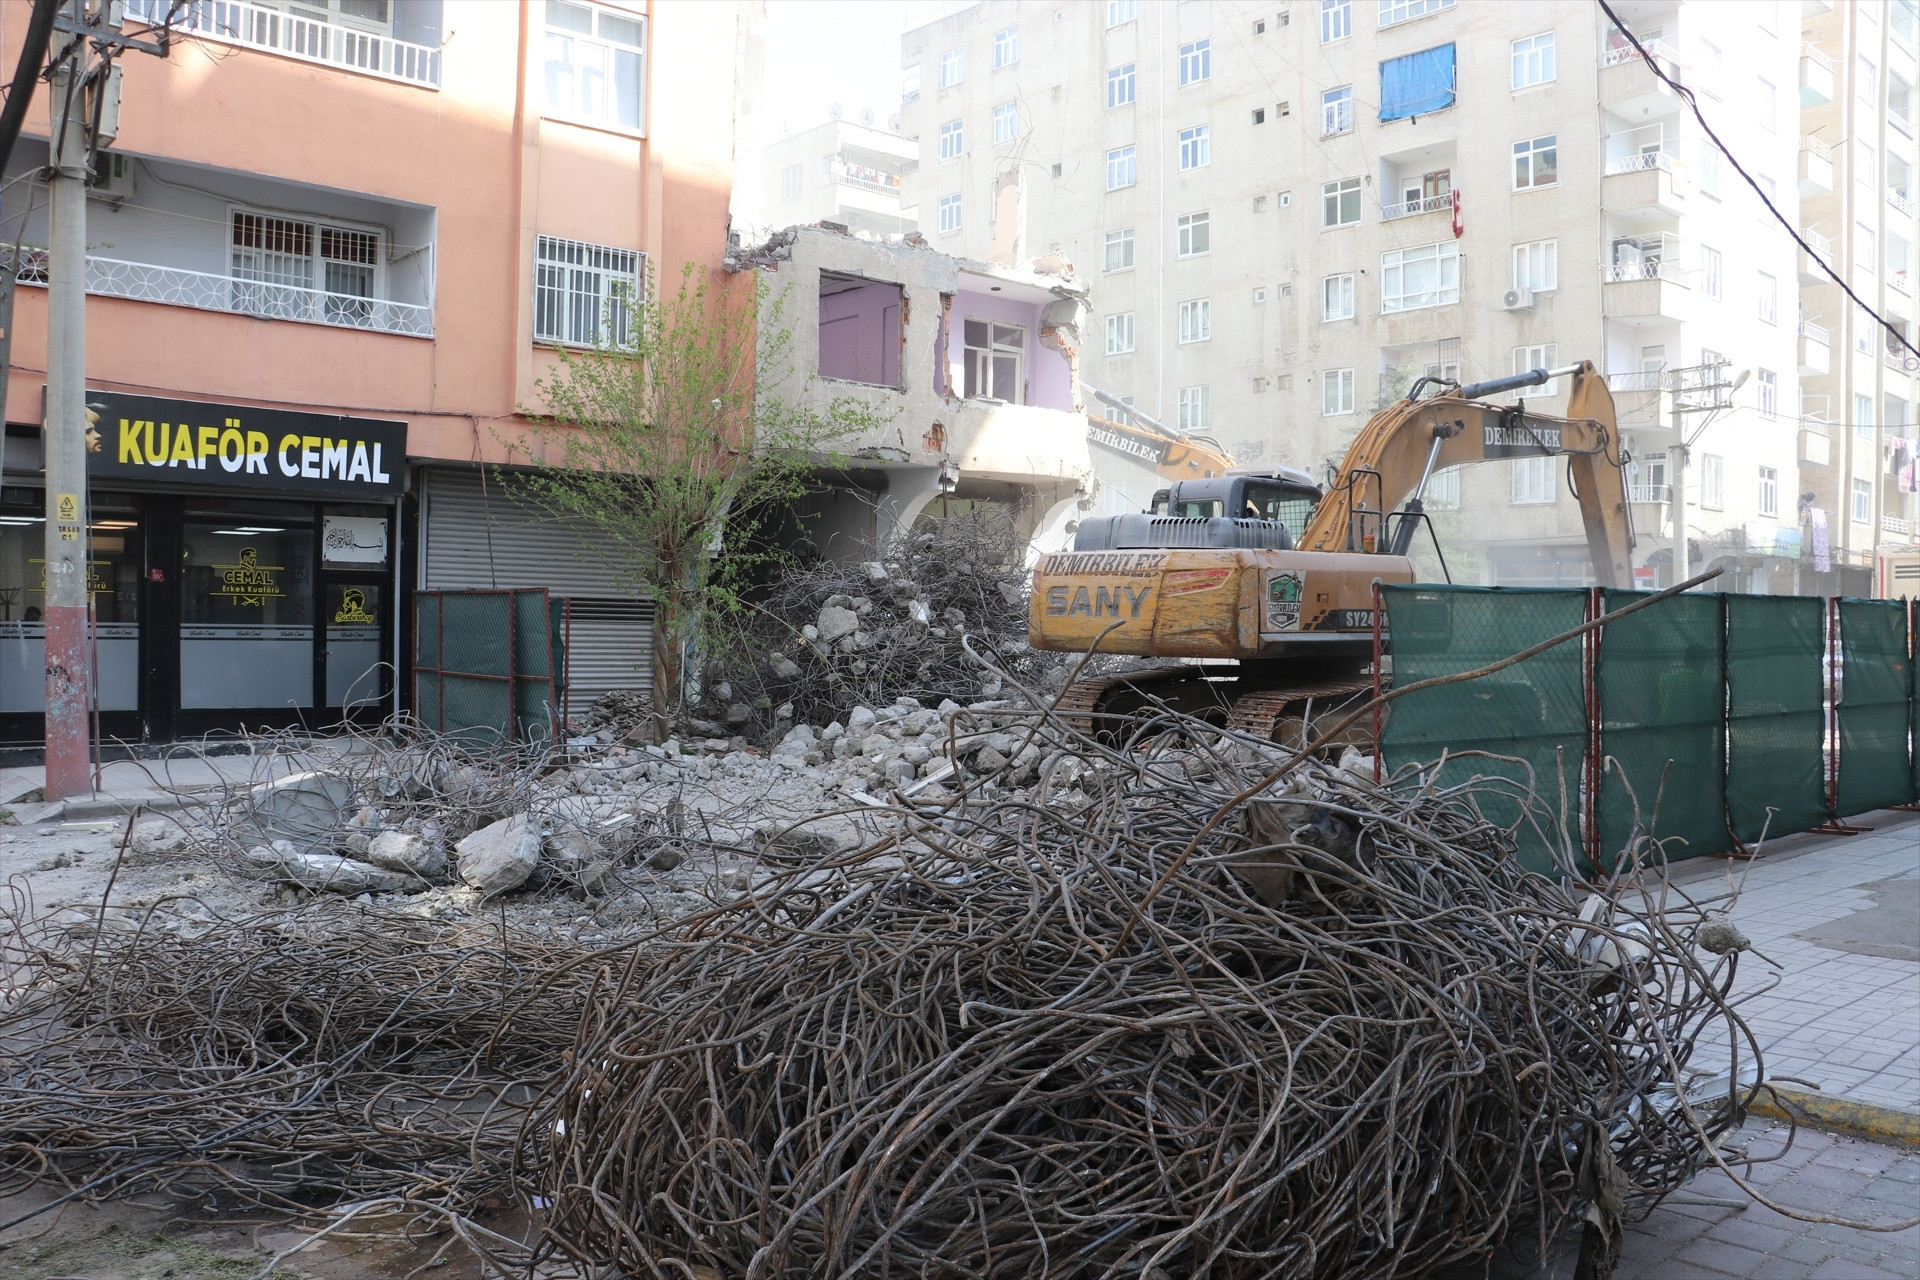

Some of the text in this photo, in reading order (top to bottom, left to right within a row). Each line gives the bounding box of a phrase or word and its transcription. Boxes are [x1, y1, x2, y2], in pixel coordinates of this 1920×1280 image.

[118, 418, 390, 484] KUAFÖR CEMAL
[224, 570, 274, 584] CEMAL
[1046, 586, 1152, 618] SANY
